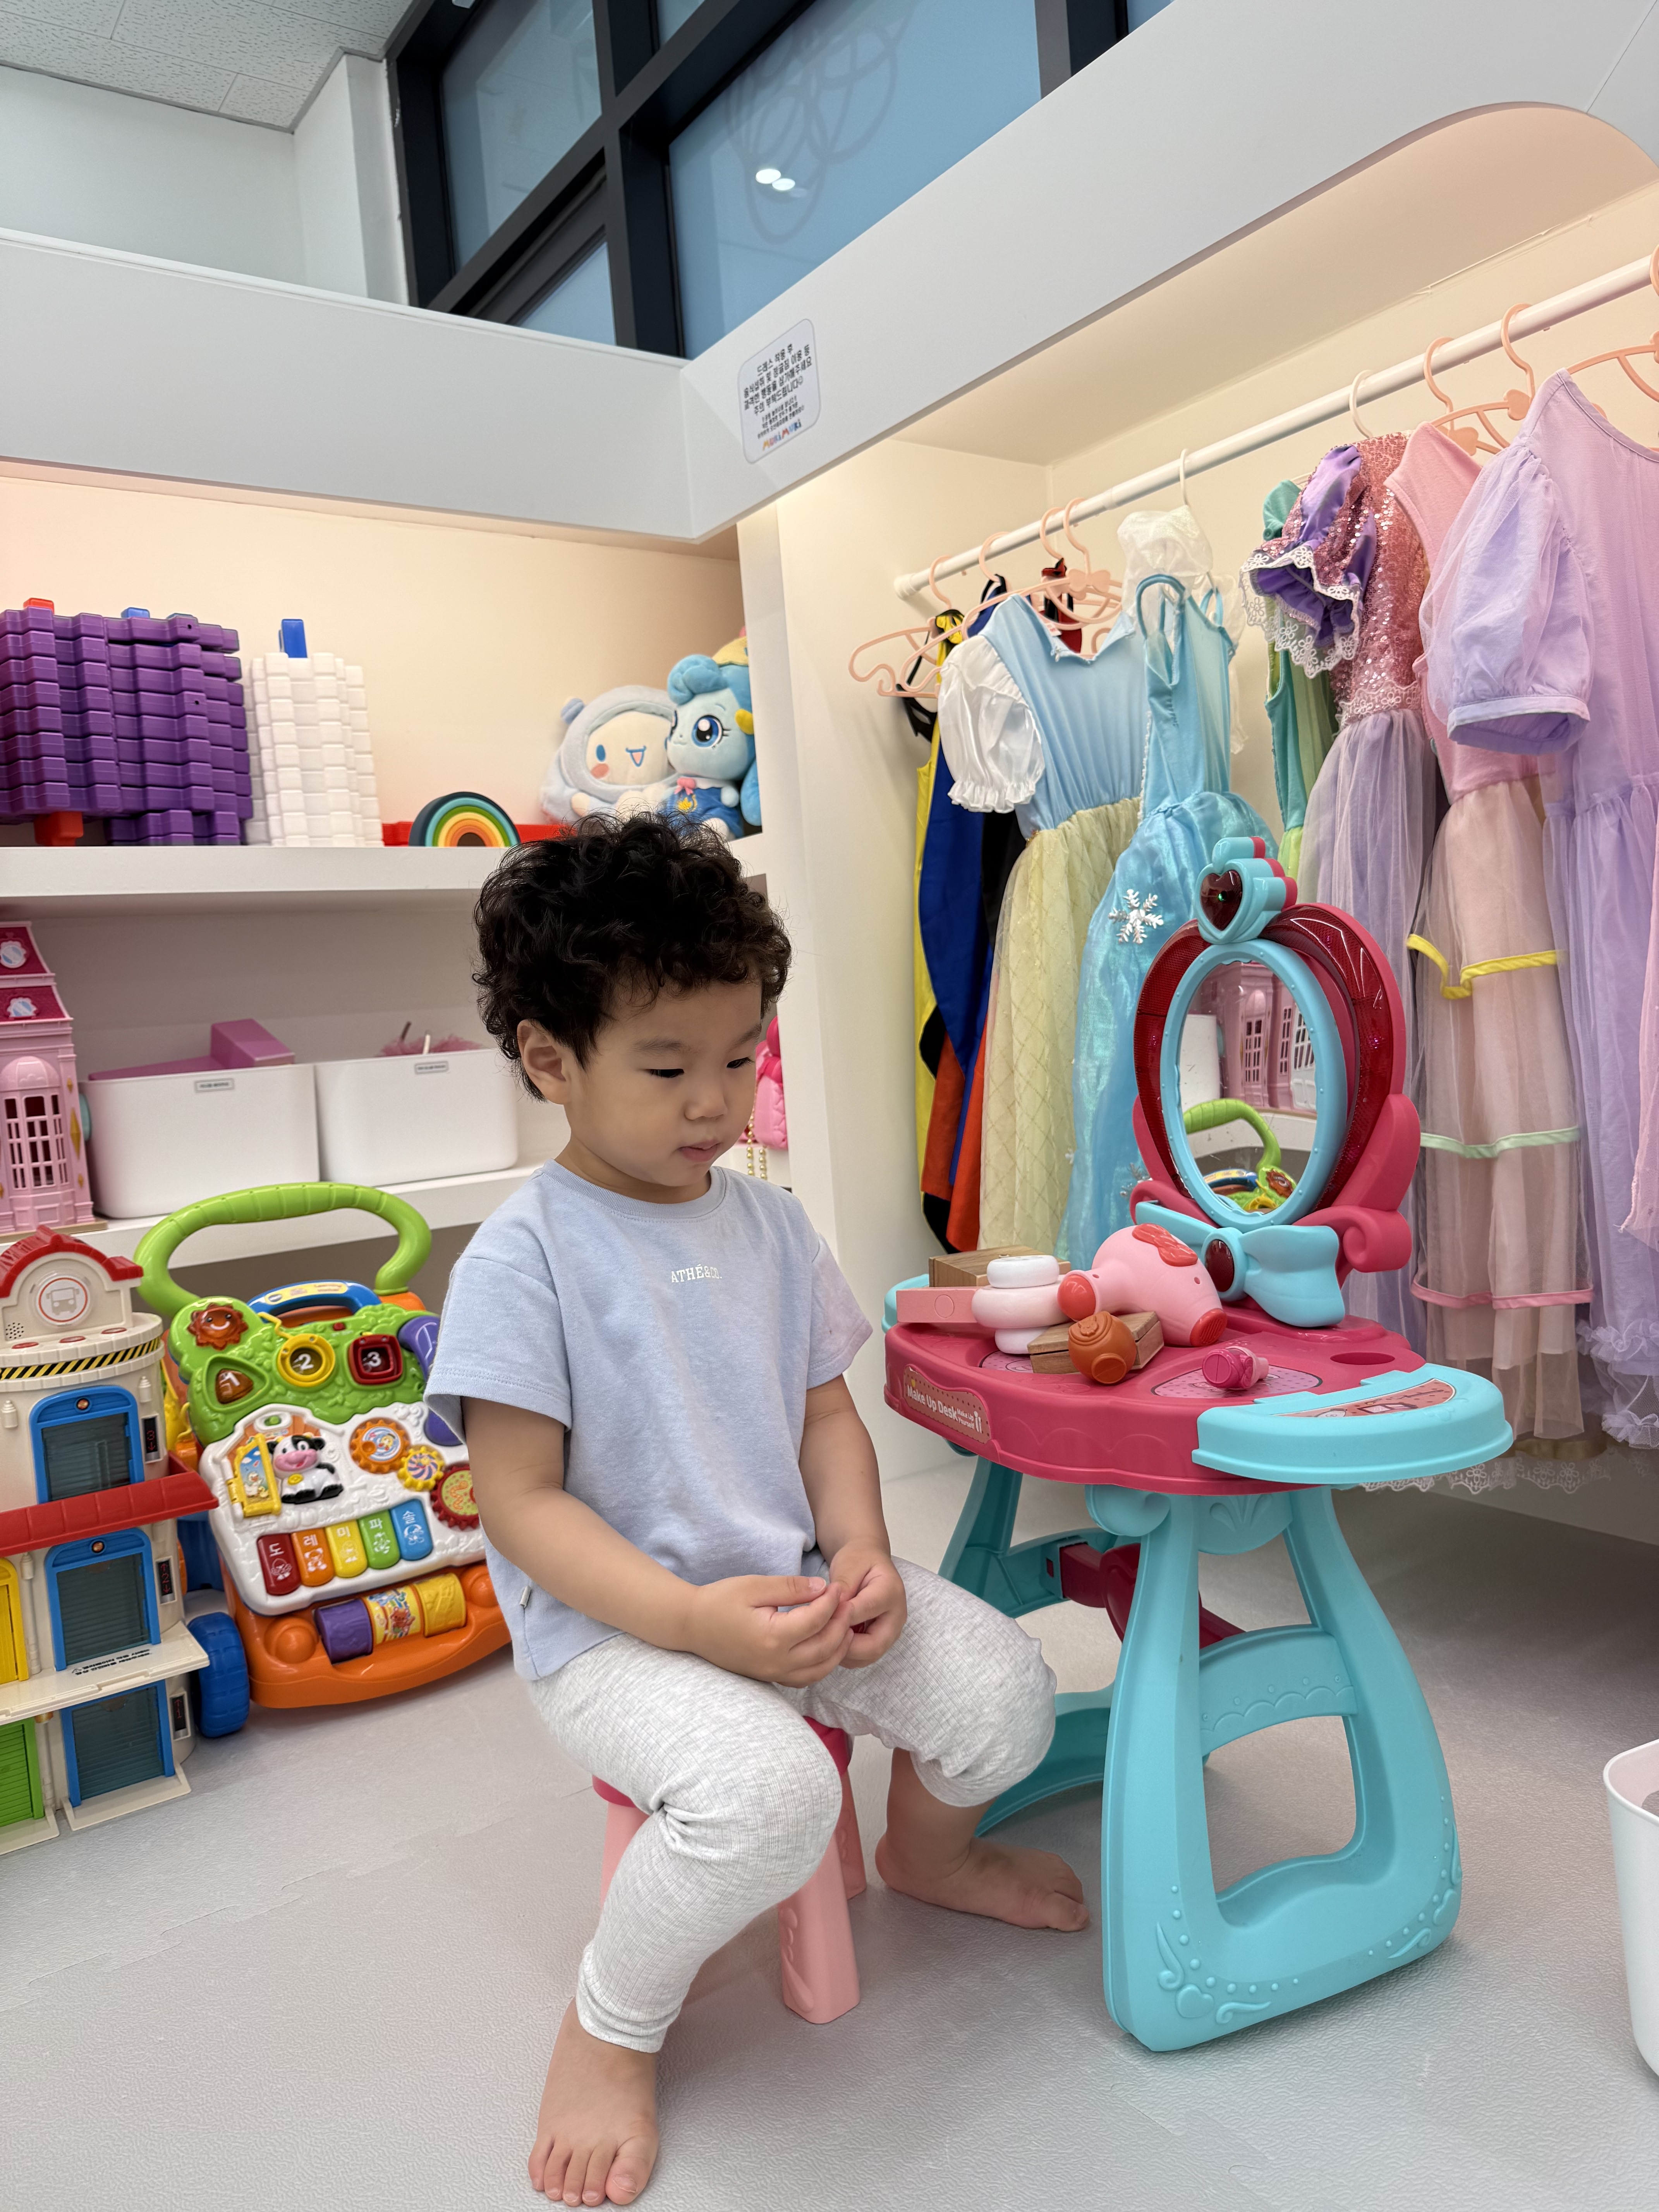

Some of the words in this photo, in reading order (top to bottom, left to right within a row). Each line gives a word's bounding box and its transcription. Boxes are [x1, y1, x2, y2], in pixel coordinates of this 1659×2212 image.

[757, 359, 773, 376] 드레스
[775, 349, 785, 362] 착용
[787, 344, 792, 354] 후
[766, 371, 771, 383] 및
[791, 350, 802, 364] 이용
[804, 345, 809, 356] 등
[754, 402, 764, 415] 주의
[298, 1353, 314, 1370] 2
[367, 1351, 381, 1367] 3
[907, 1384, 926, 1405] Make
[926, 1394, 937, 1412] Up
[938, 1400, 958, 1421] Desk
[957, 1408, 968, 1419] Make
[968, 1413, 974, 1422] Up
[958, 1417, 975, 1430] Yourself
[146, 1430, 155, 1441] 3
[369, 1518, 383, 1529] 파
[402, 1510, 416, 1525] 솔
[336, 1526, 350, 1537] 미
[304, 1534, 318, 1546] 레
[269, 1543, 285, 1557] 도
[161, 1573, 170, 1584] 2
